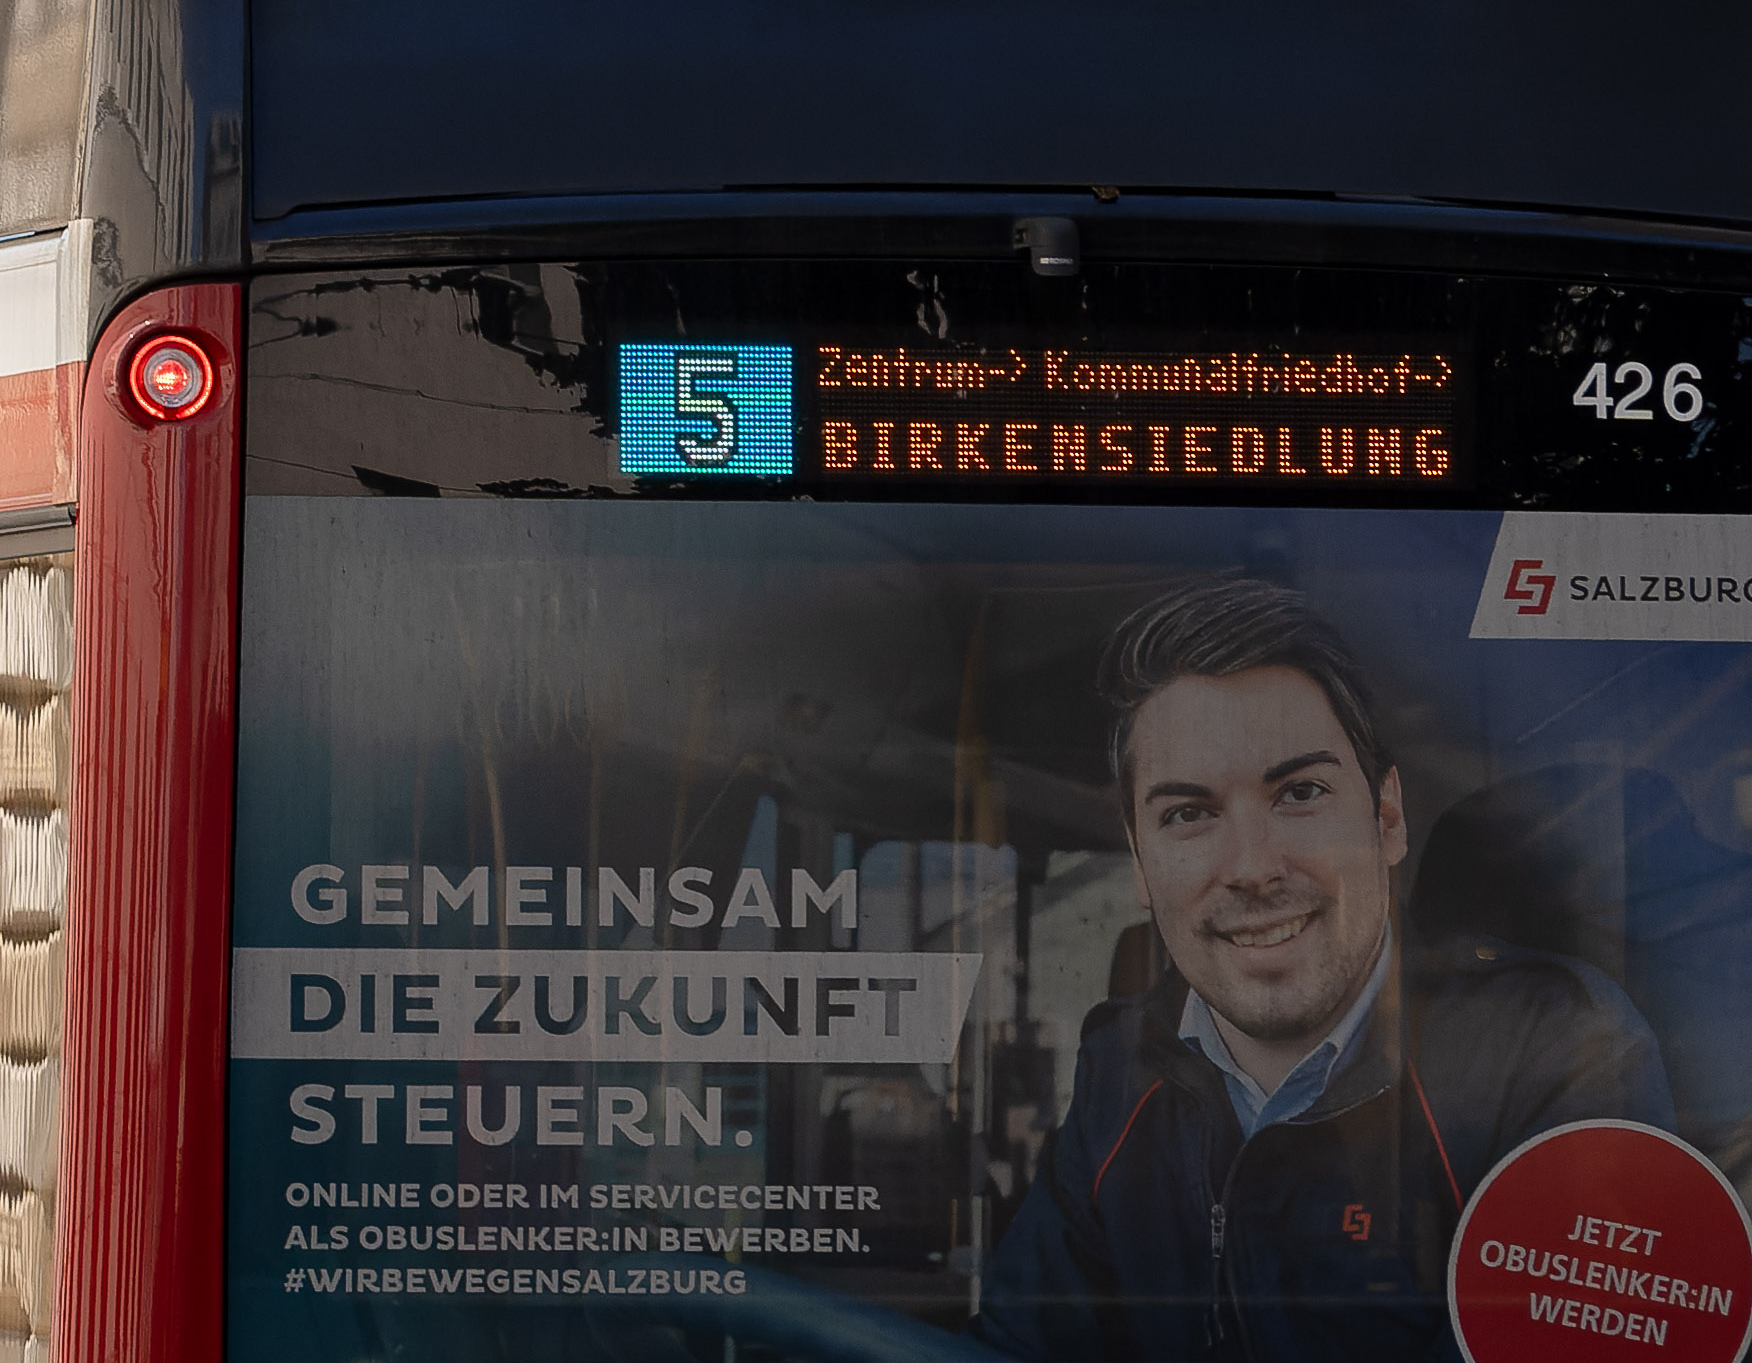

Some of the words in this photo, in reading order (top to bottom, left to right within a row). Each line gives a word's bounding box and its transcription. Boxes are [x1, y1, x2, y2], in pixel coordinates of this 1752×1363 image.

[677, 357, 735, 461] 5
[1572, 361, 1704, 422] 426
[823, 421, 1449, 476] BIRKENSIEDLUNG
[289, 864, 858, 929] GEMEINSAM
[289, 973, 441, 1035] DIE
[473, 974, 918, 1037] ZUKUNFT
[289, 1084, 754, 1147] STEUERN.
[285, 1182, 421, 1209] ONLINE
[430, 1183, 530, 1209] ODER
[540, 1184, 580, 1209] IM
[589, 1184, 881, 1211] SERVICECENTER
[284, 1225, 348, 1251] ALS
[358, 1225, 648, 1252] OBUSLENKER:IN
[659, 1227, 871, 1253] BEWERBEN.
[1567, 1215, 1663, 1256] JETZT
[284, 1267, 747, 1295] #WIRBEWEGENSALZBURG
[1480, 1240, 1734, 1316] OBUSLENKER:IN
[1530, 1292, 1669, 1347] WERDEN
